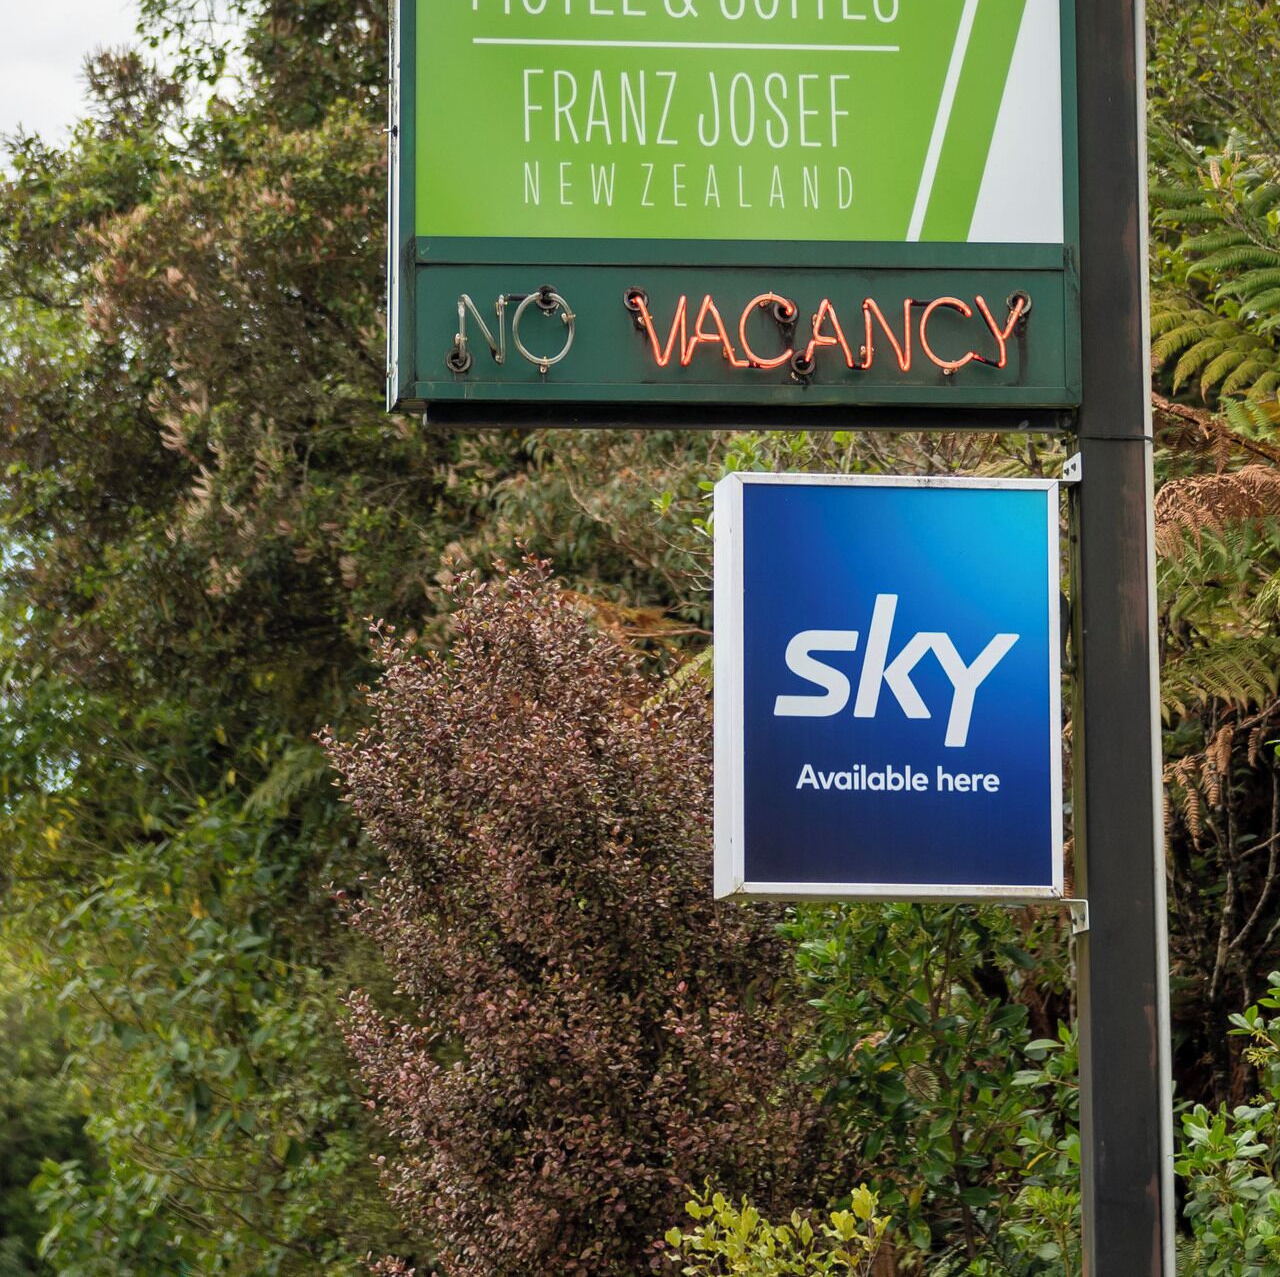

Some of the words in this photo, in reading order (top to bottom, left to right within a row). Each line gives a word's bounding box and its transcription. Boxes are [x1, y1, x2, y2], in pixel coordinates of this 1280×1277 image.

[523, 69, 678, 146] FRANZ
[698, 71, 851, 149] JOSEF
[524, 162, 616, 206] NEW
[642, 164, 854, 210] ZEALAND
[457, 292, 576, 367] NO
[630, 292, 1026, 372] VACANCY
[774, 594, 1020, 748] sky
[796, 764, 929, 792] Available
[937, 765, 1001, 793] here
